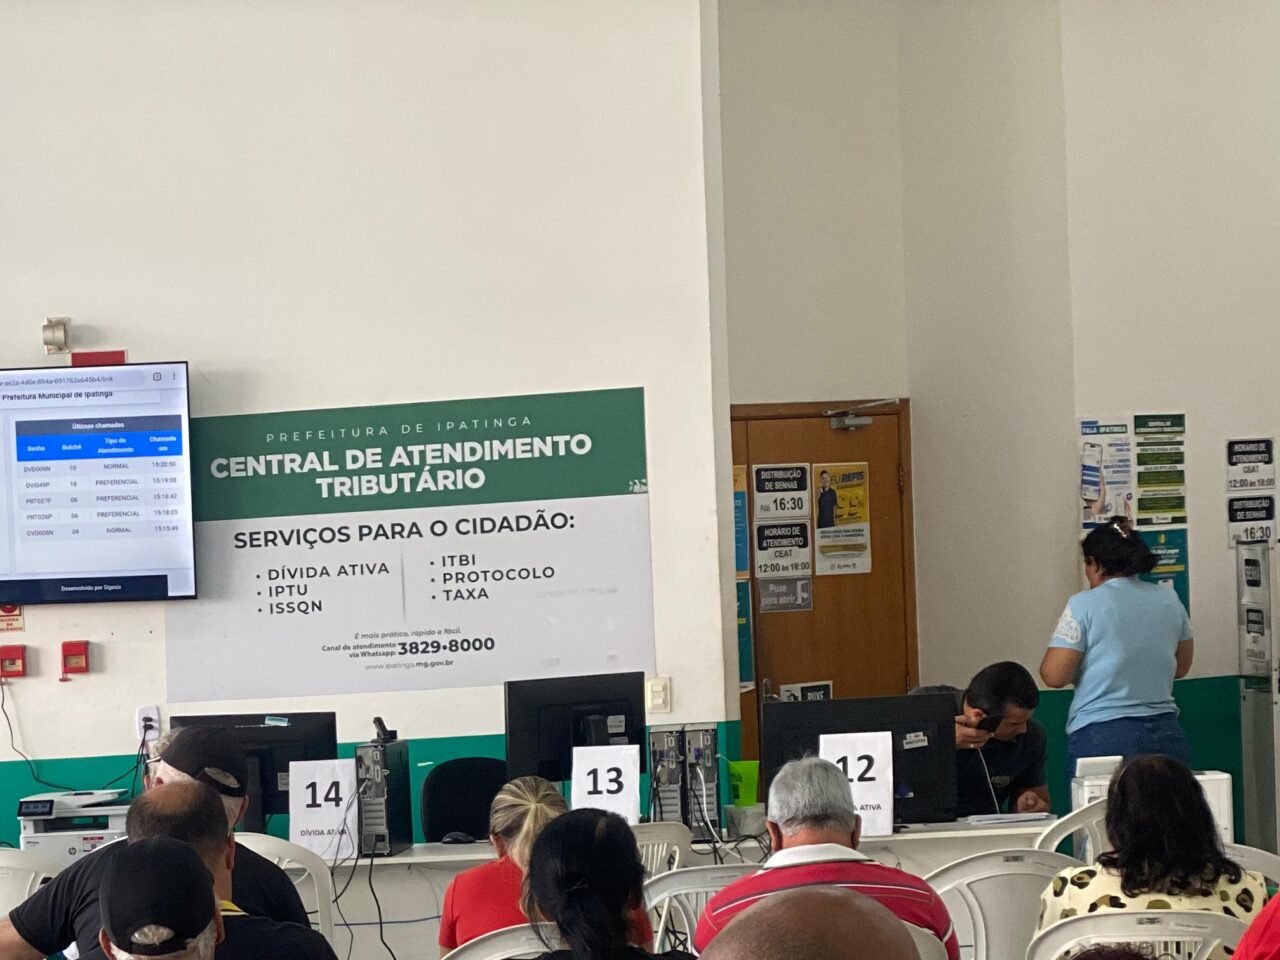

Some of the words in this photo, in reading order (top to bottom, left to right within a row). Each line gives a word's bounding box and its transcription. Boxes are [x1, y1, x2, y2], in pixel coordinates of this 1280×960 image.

[2, 392, 37, 401] Prefeitura
[38, 391, 73, 400] Municipal
[74, 390, 83, 398] de
[84, 390, 113, 399] Ipatinga
[266, 425, 389, 443] PREFEITURA
[401, 423, 426, 435] DE
[437, 415, 532, 432] IPATINGA
[210, 451, 339, 479] CENTRAL
[346, 447, 382, 471] DE
[389, 433, 593, 468] ATENDIMENTO
[761, 469, 802, 480] DISTRIBUIÇÃO
[316, 466, 486, 499] TRIBUTÁRIO
[765, 481, 774, 490] DE
[774, 480, 798, 490] SENHAS
[773, 497, 803, 511] 16:30
[233, 526, 352, 551] SERVIÇOS
[358, 521, 424, 542] PARA
[429, 519, 449, 538] O
[454, 510, 576, 535] CIDADÃO:
[764, 527, 792, 537] HORÁRIO
[792, 526, 801, 535] DE
[1244, 526, 1272, 540] 16:30
[762, 537, 804, 548] ATENDIMENTO
[441, 553, 476, 568] ITBI
[774, 549, 793, 558] CEAT
[268, 565, 331, 581] DÍVIDA
[337, 562, 390, 577] ATIVA
[758, 563, 781, 573] 12:00
[442, 566, 556, 585] PROTOCOLO
[268, 583, 308, 598] IPTU
[442, 587, 489, 602] TAXA
[769, 583, 788, 592] Puxe
[269, 600, 323, 615] ISSQN
[381, 630, 410, 639] prático,
[411, 629, 436, 638] rápido
[322, 644, 341, 652] Canal
[352, 642, 397, 650] atendimento
[360, 650, 397, 659] Whatsapp:
[365, 659, 454, 671] www.ipatinga.mg.gov.br
[836, 754, 877, 783] 12
[586, 766, 624, 796] 13
[305, 780, 343, 809] 14
[859, 803, 882, 811] ATIVA
[300, 829, 325, 837] DÍVIDA
